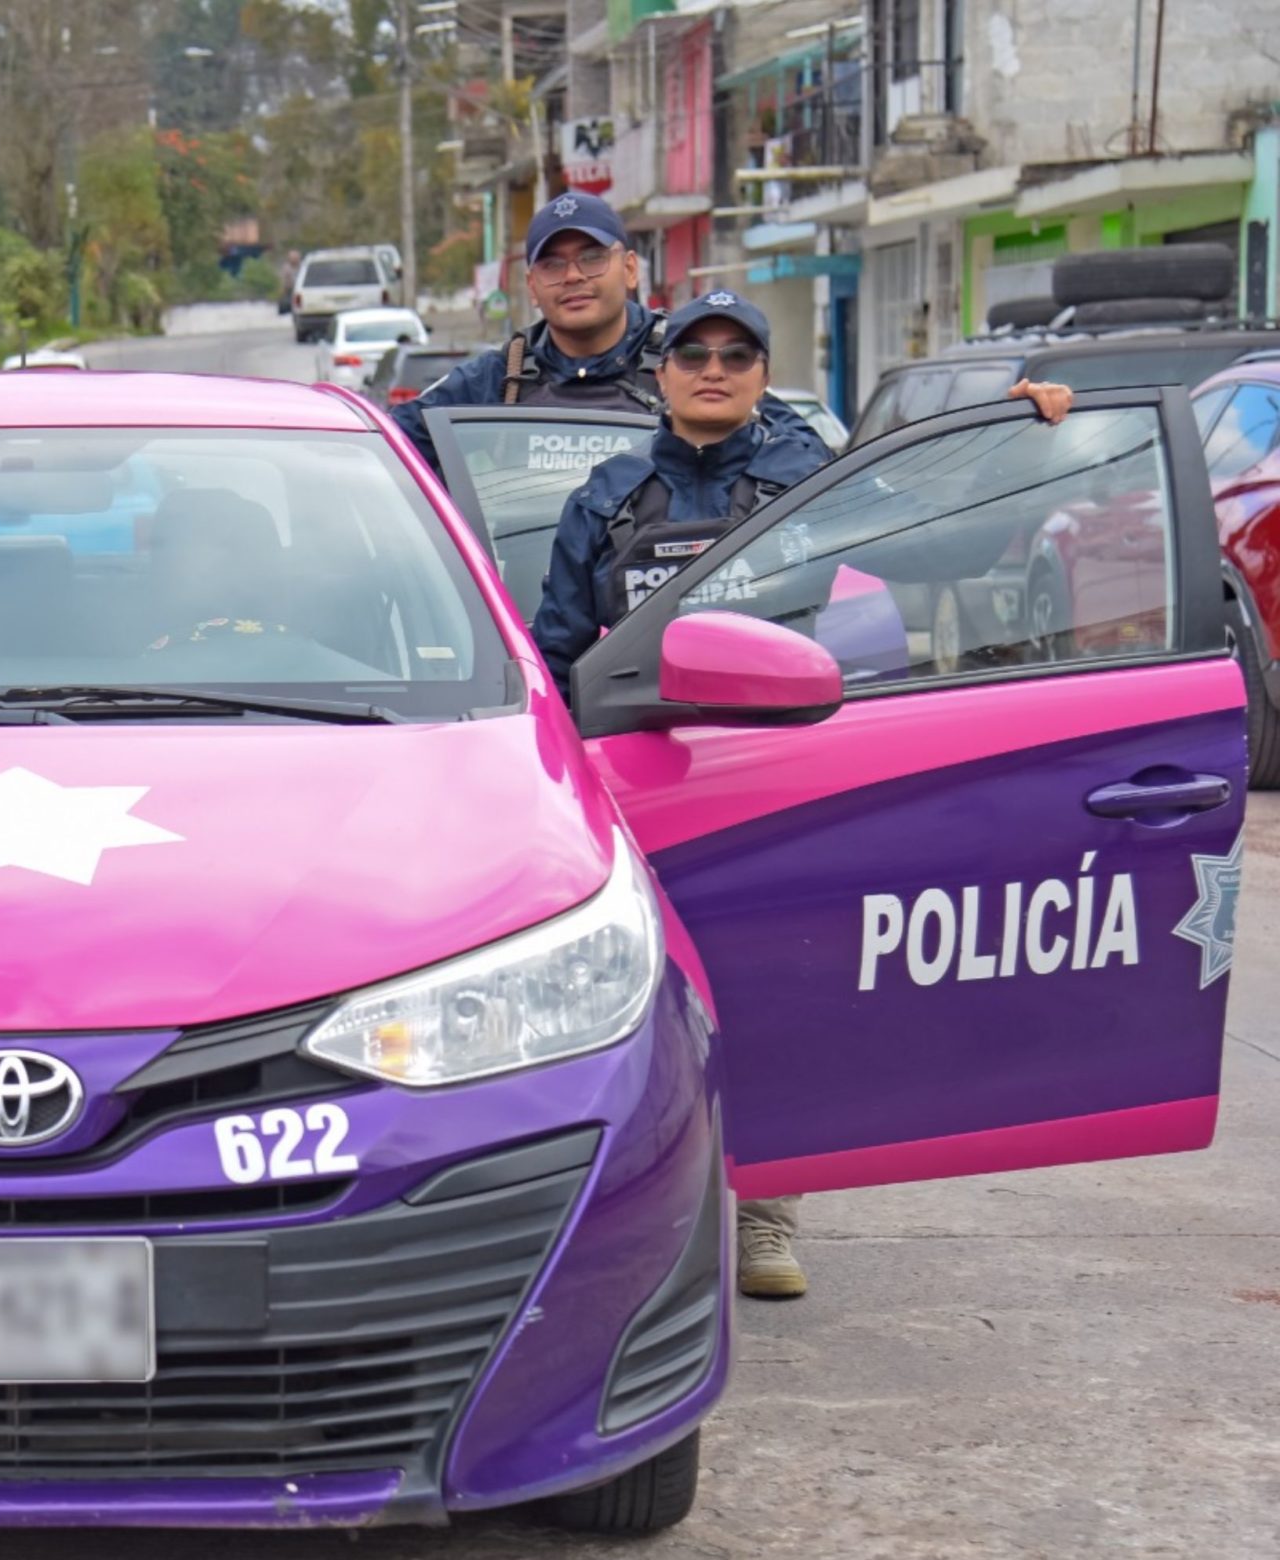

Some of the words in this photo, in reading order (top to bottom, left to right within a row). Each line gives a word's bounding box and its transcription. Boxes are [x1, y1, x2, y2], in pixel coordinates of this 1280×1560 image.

[527, 452, 616, 470] MUNICIP
[528, 435, 633, 453] POLICIA
[858, 850, 1139, 991] POLICÍA
[214, 1103, 358, 1184] 622
